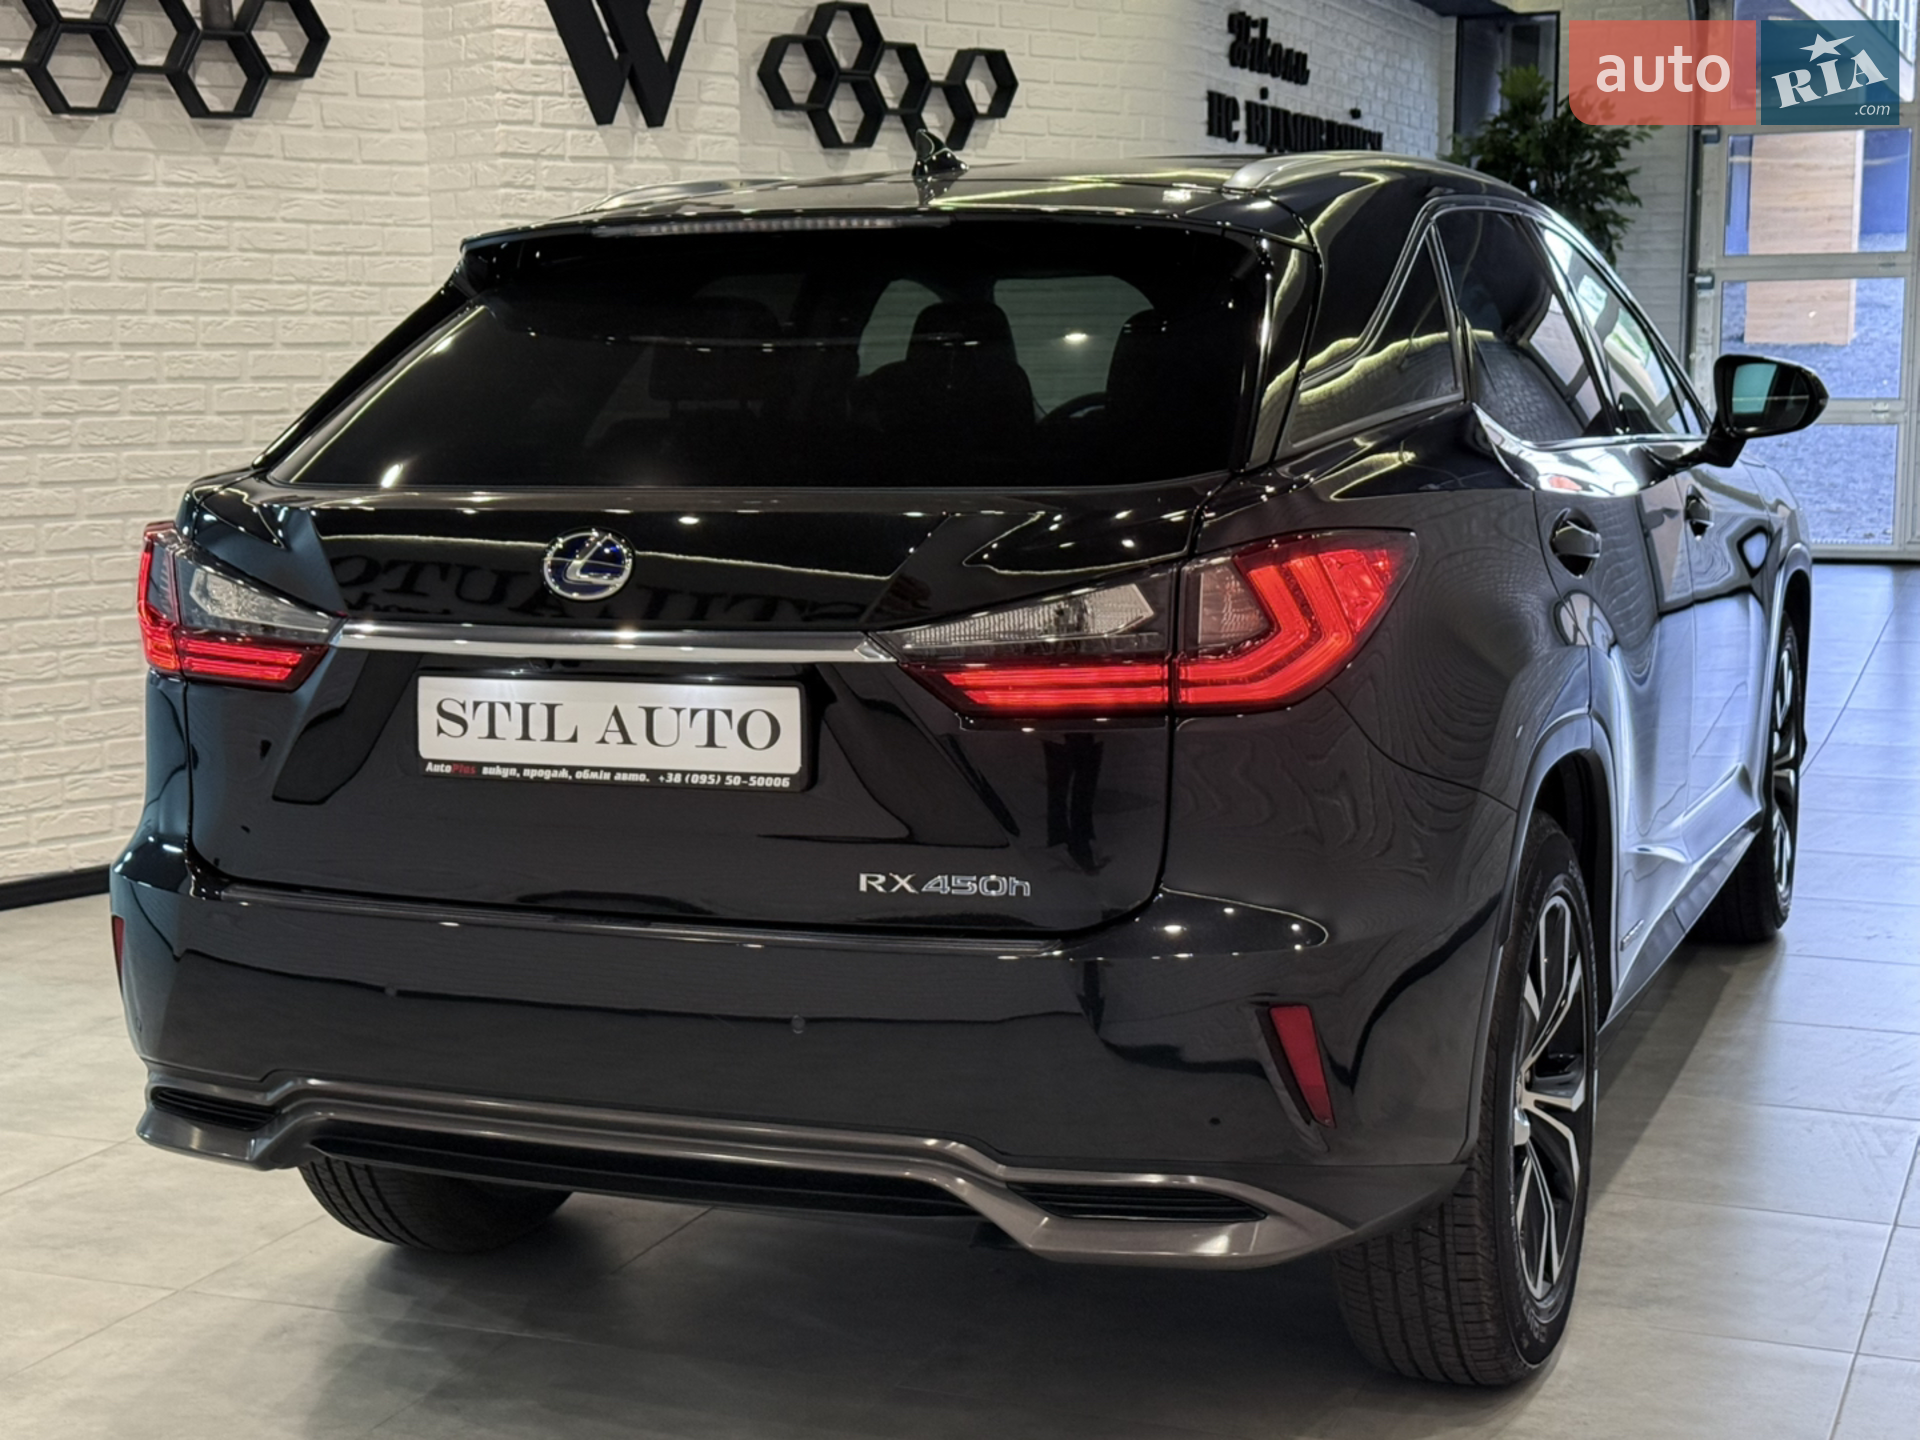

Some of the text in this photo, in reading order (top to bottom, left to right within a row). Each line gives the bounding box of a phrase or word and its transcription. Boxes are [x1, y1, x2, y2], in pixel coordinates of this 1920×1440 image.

[435, 697, 782, 751] STIL AUTO
[658, 772, 682, 784] +38
[684, 773, 722, 786] (095)
